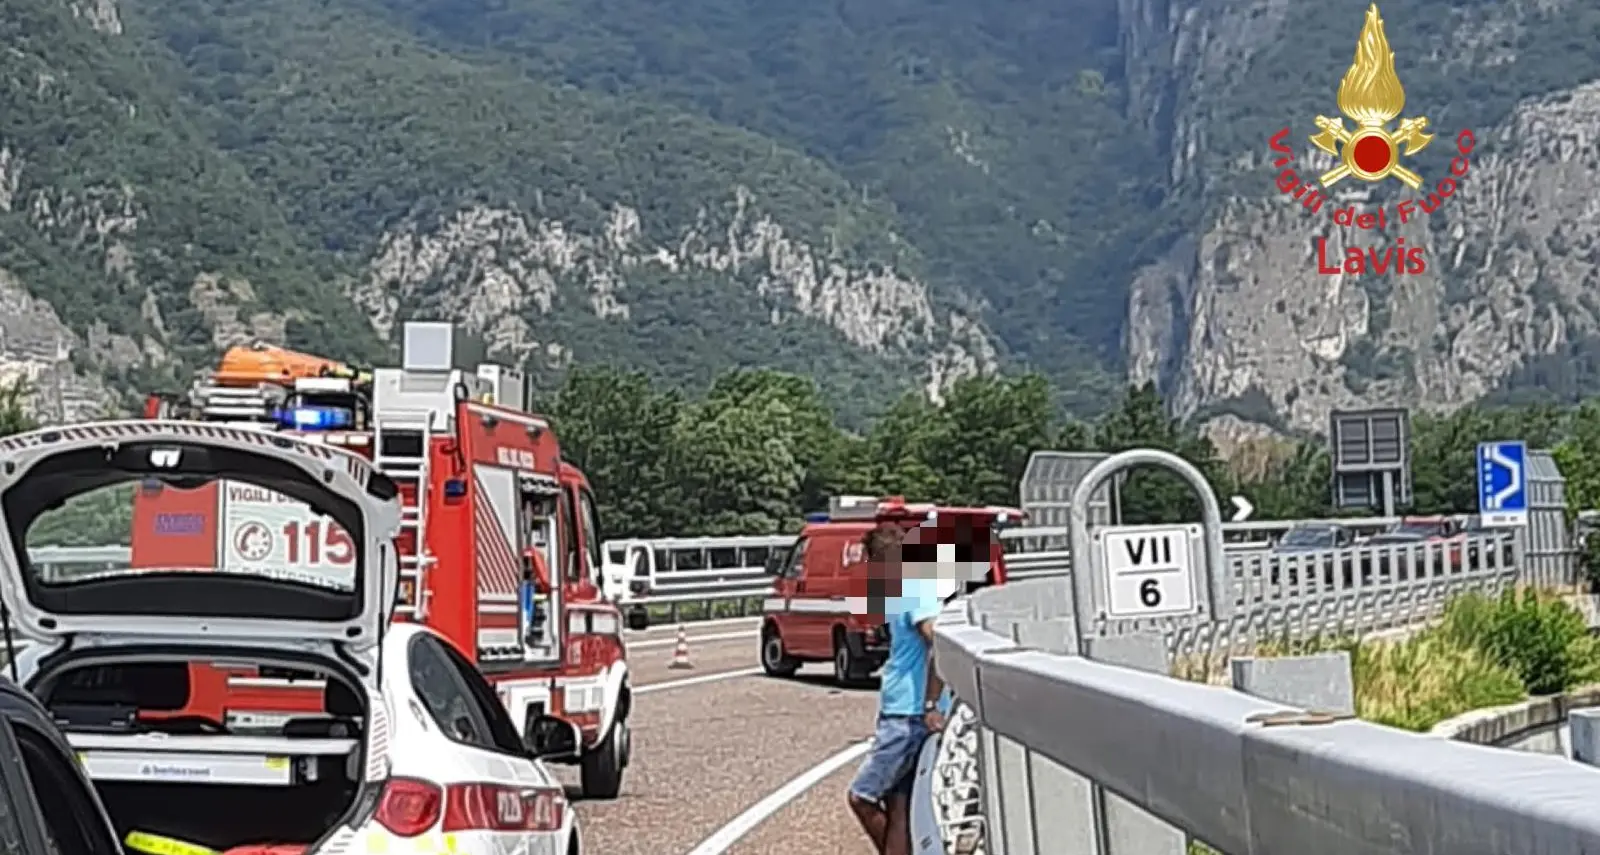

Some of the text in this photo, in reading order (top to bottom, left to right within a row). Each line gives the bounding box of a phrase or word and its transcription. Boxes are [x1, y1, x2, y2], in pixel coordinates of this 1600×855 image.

[229, 487, 272, 503] VIGILI
[283, 520, 355, 565] 115
[1124, 536, 1172, 566] VII
[1140, 578, 1162, 608] 6
